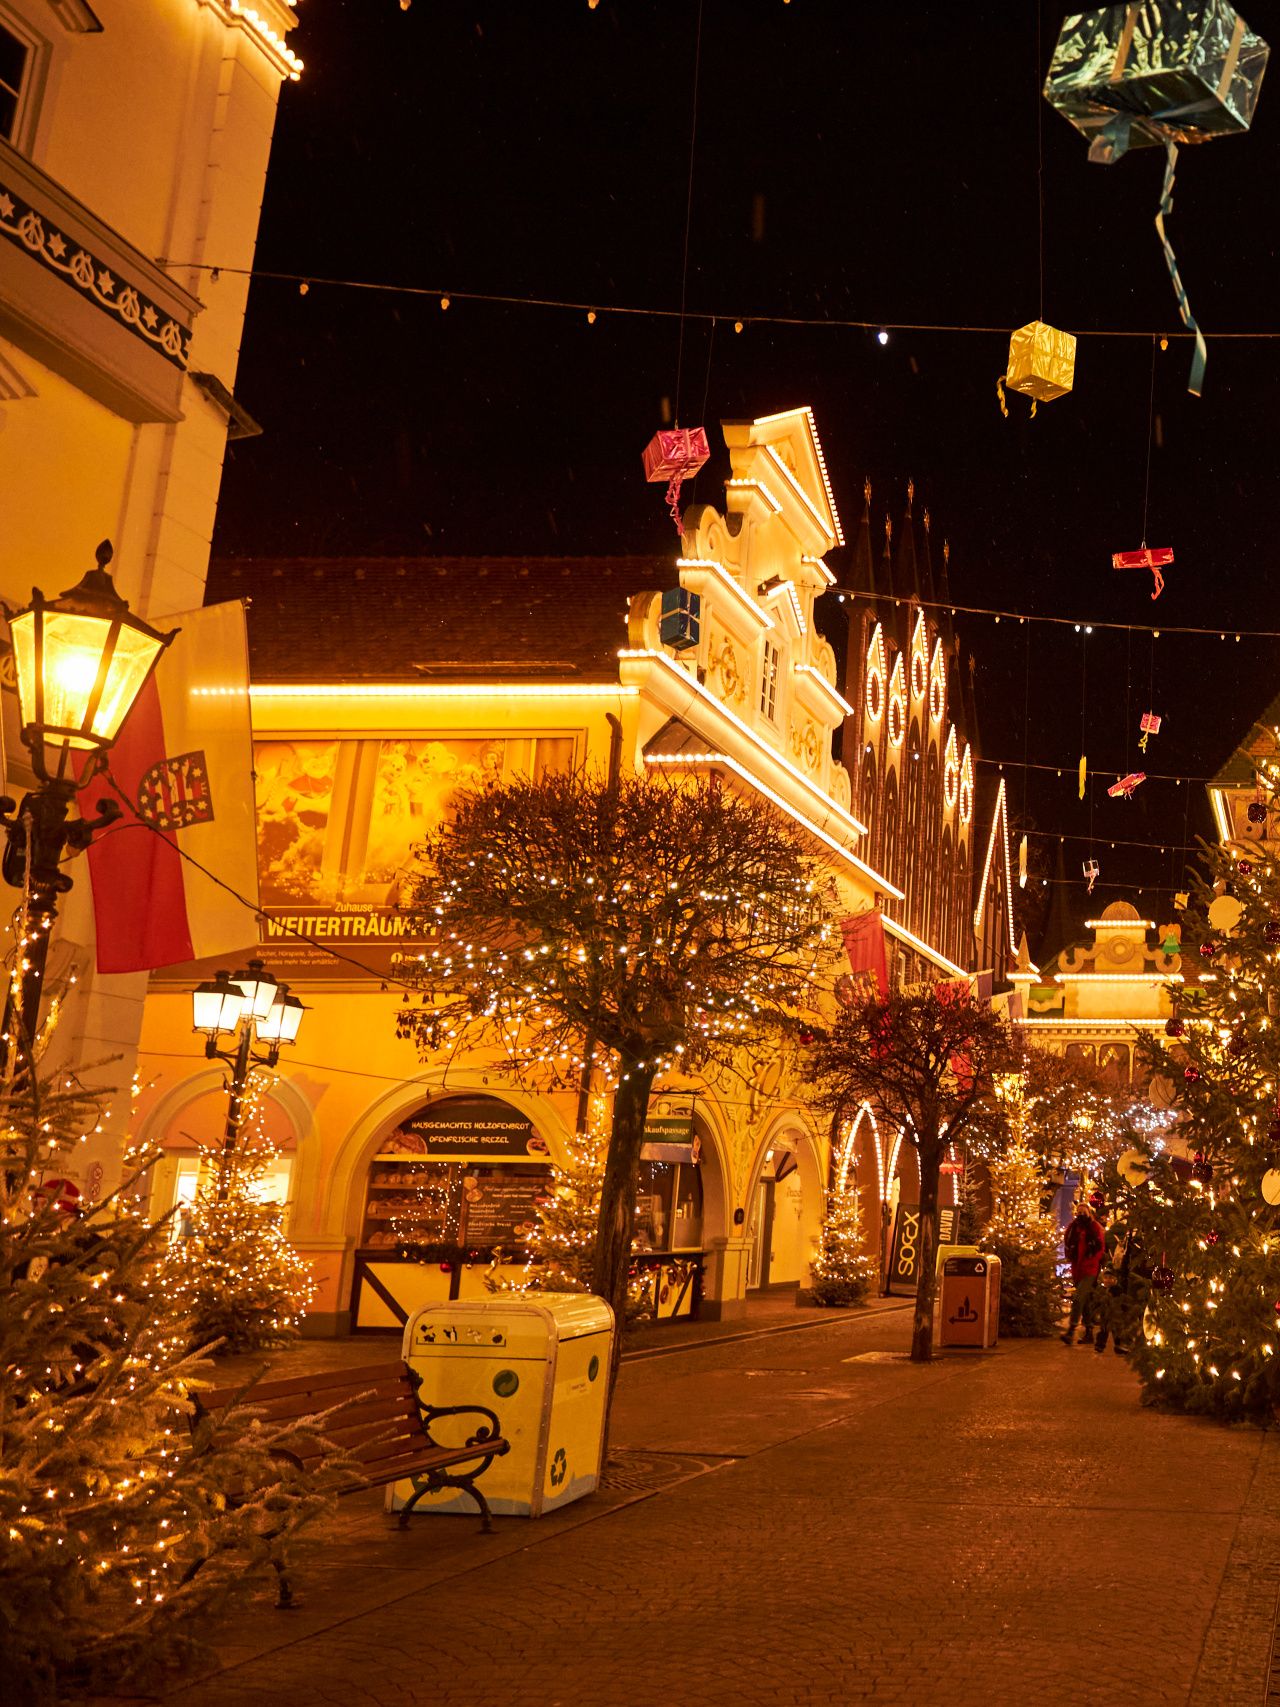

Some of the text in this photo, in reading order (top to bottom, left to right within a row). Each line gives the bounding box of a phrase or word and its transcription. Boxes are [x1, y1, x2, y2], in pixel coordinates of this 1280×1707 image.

[335, 903, 373, 912] Zuhause
[412, 1121, 529, 1130] HAUSGEMACHTES HOLZOFENBROT
[481, 1136, 509, 1144] BREZEL
[938, 1209, 954, 1241] DAVID
